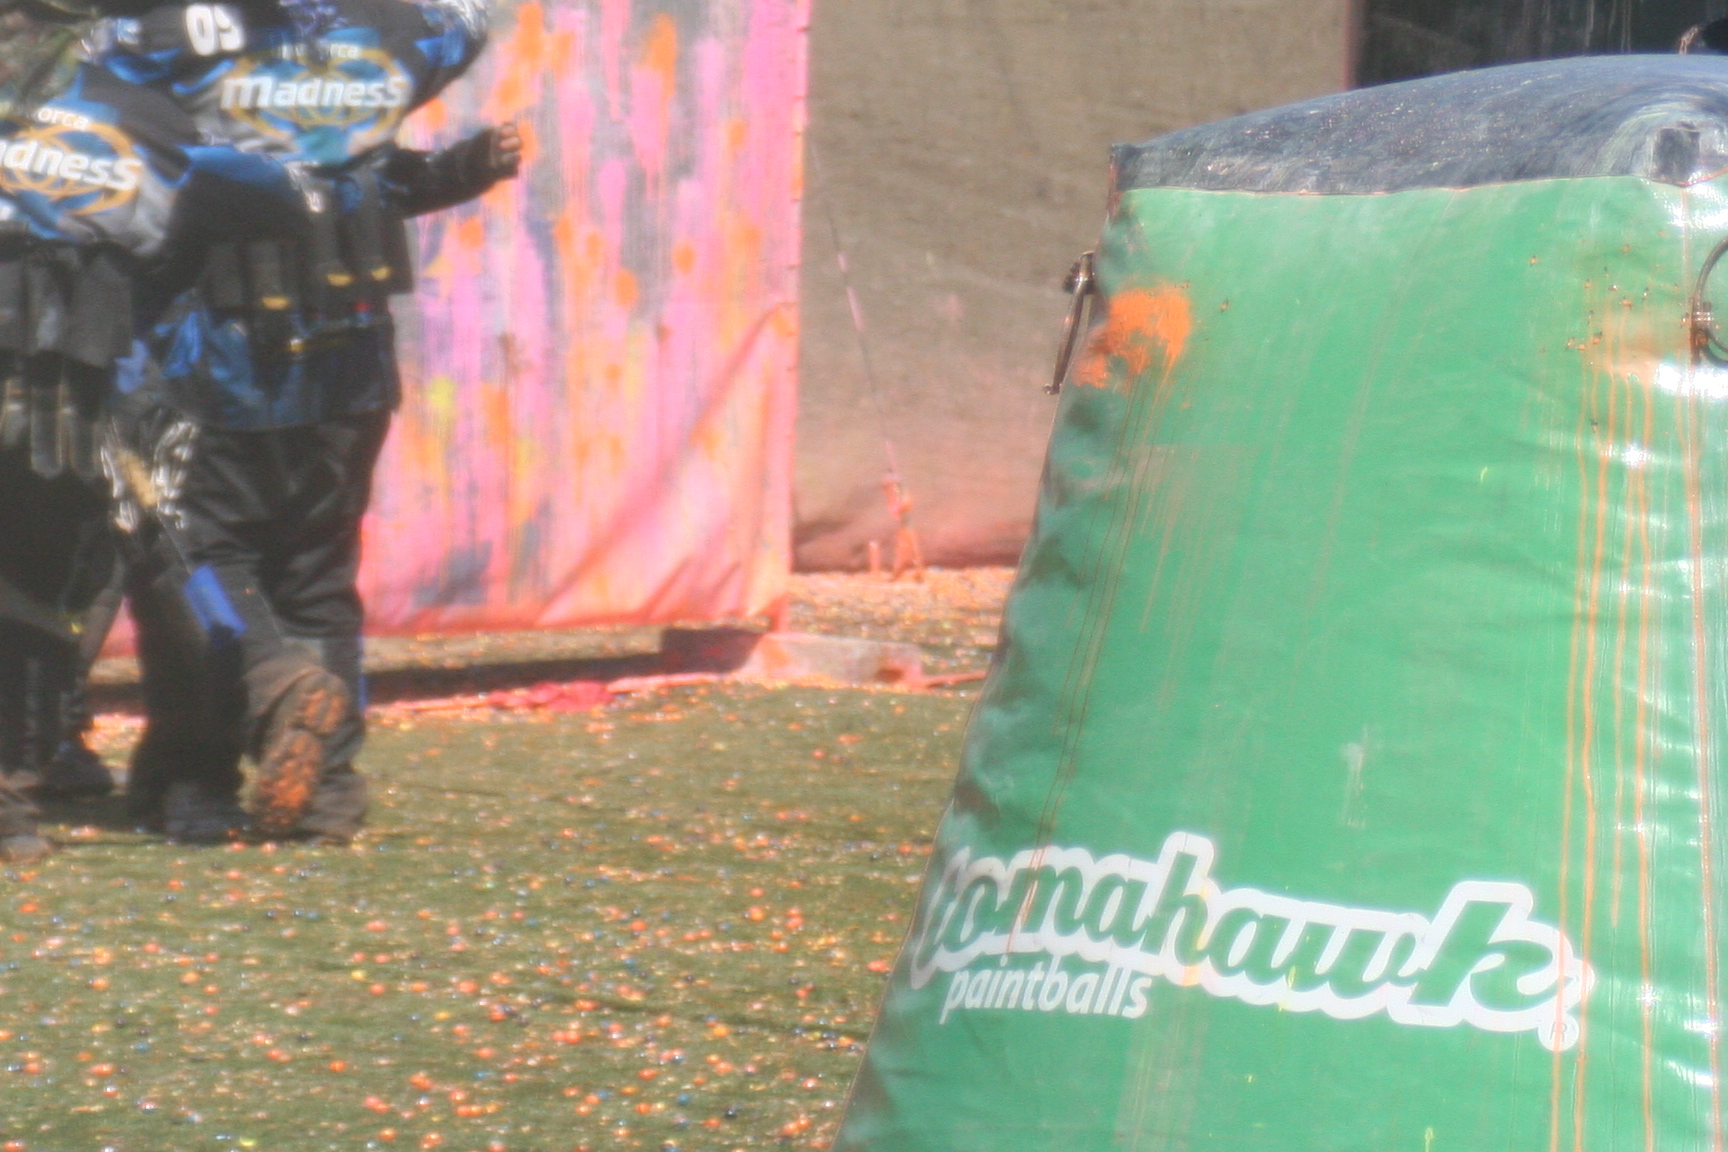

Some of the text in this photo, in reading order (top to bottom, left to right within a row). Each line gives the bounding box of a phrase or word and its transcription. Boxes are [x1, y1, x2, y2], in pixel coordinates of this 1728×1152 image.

[37, 105, 89, 131] orca
[910, 830, 1596, 1032] tomahawk
[938, 952, 1152, 1025] paintballs
